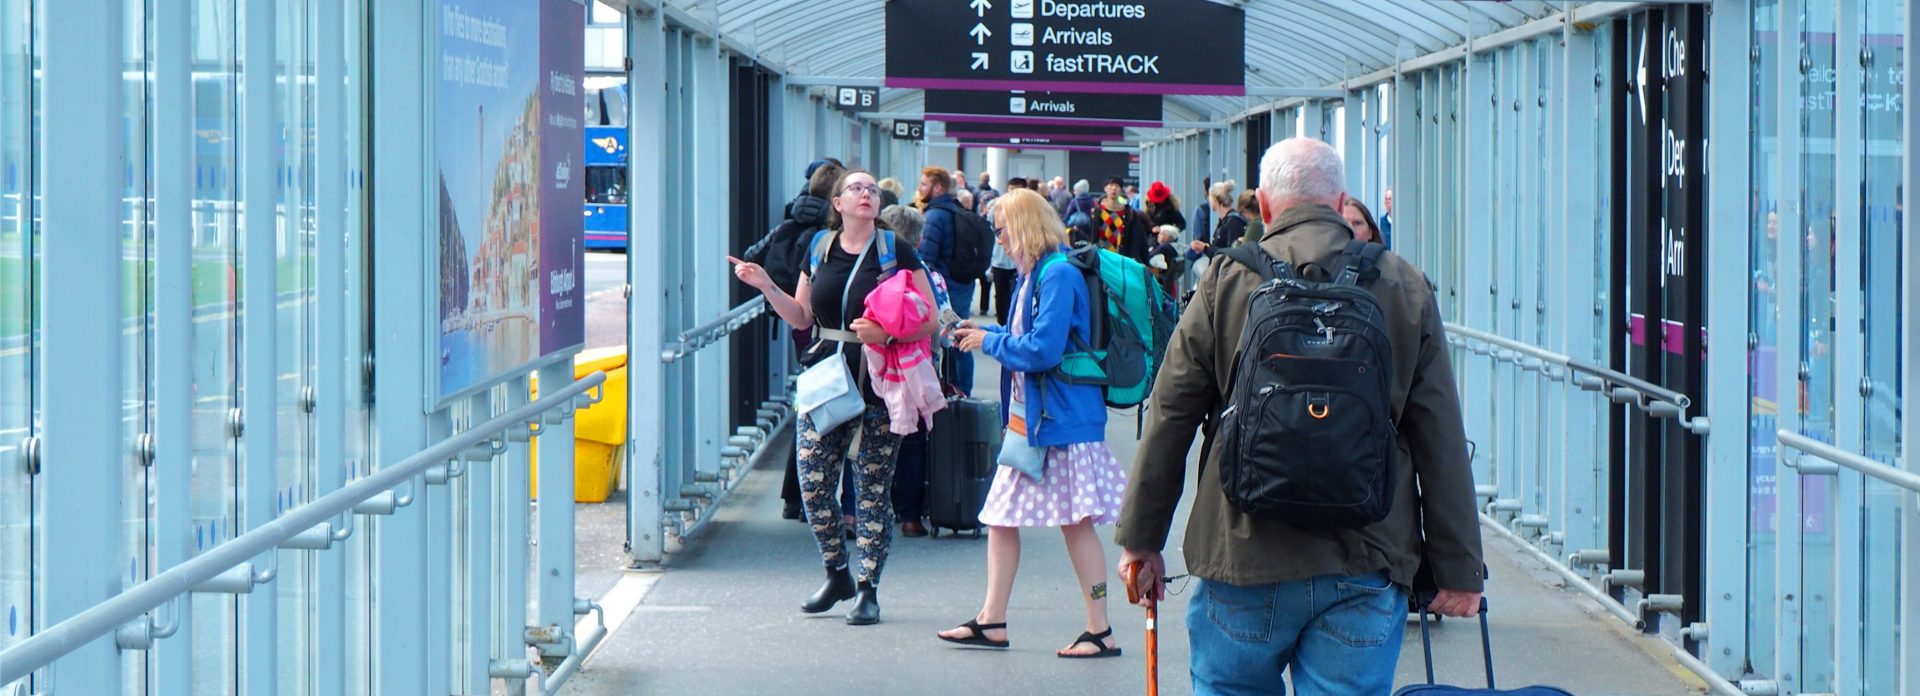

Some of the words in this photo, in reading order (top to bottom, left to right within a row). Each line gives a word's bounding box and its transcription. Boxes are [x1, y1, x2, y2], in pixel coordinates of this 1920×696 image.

[1041, 0, 1145, 20] Departures
[1042, 26, 1113, 45] Arrivals
[1046, 53, 1159, 74] fastTRACK
[861, 94, 872, 106] B
[1030, 100, 1075, 113] Arrivals
[911, 127, 920, 137] C
[1667, 227, 1684, 276] Arri
